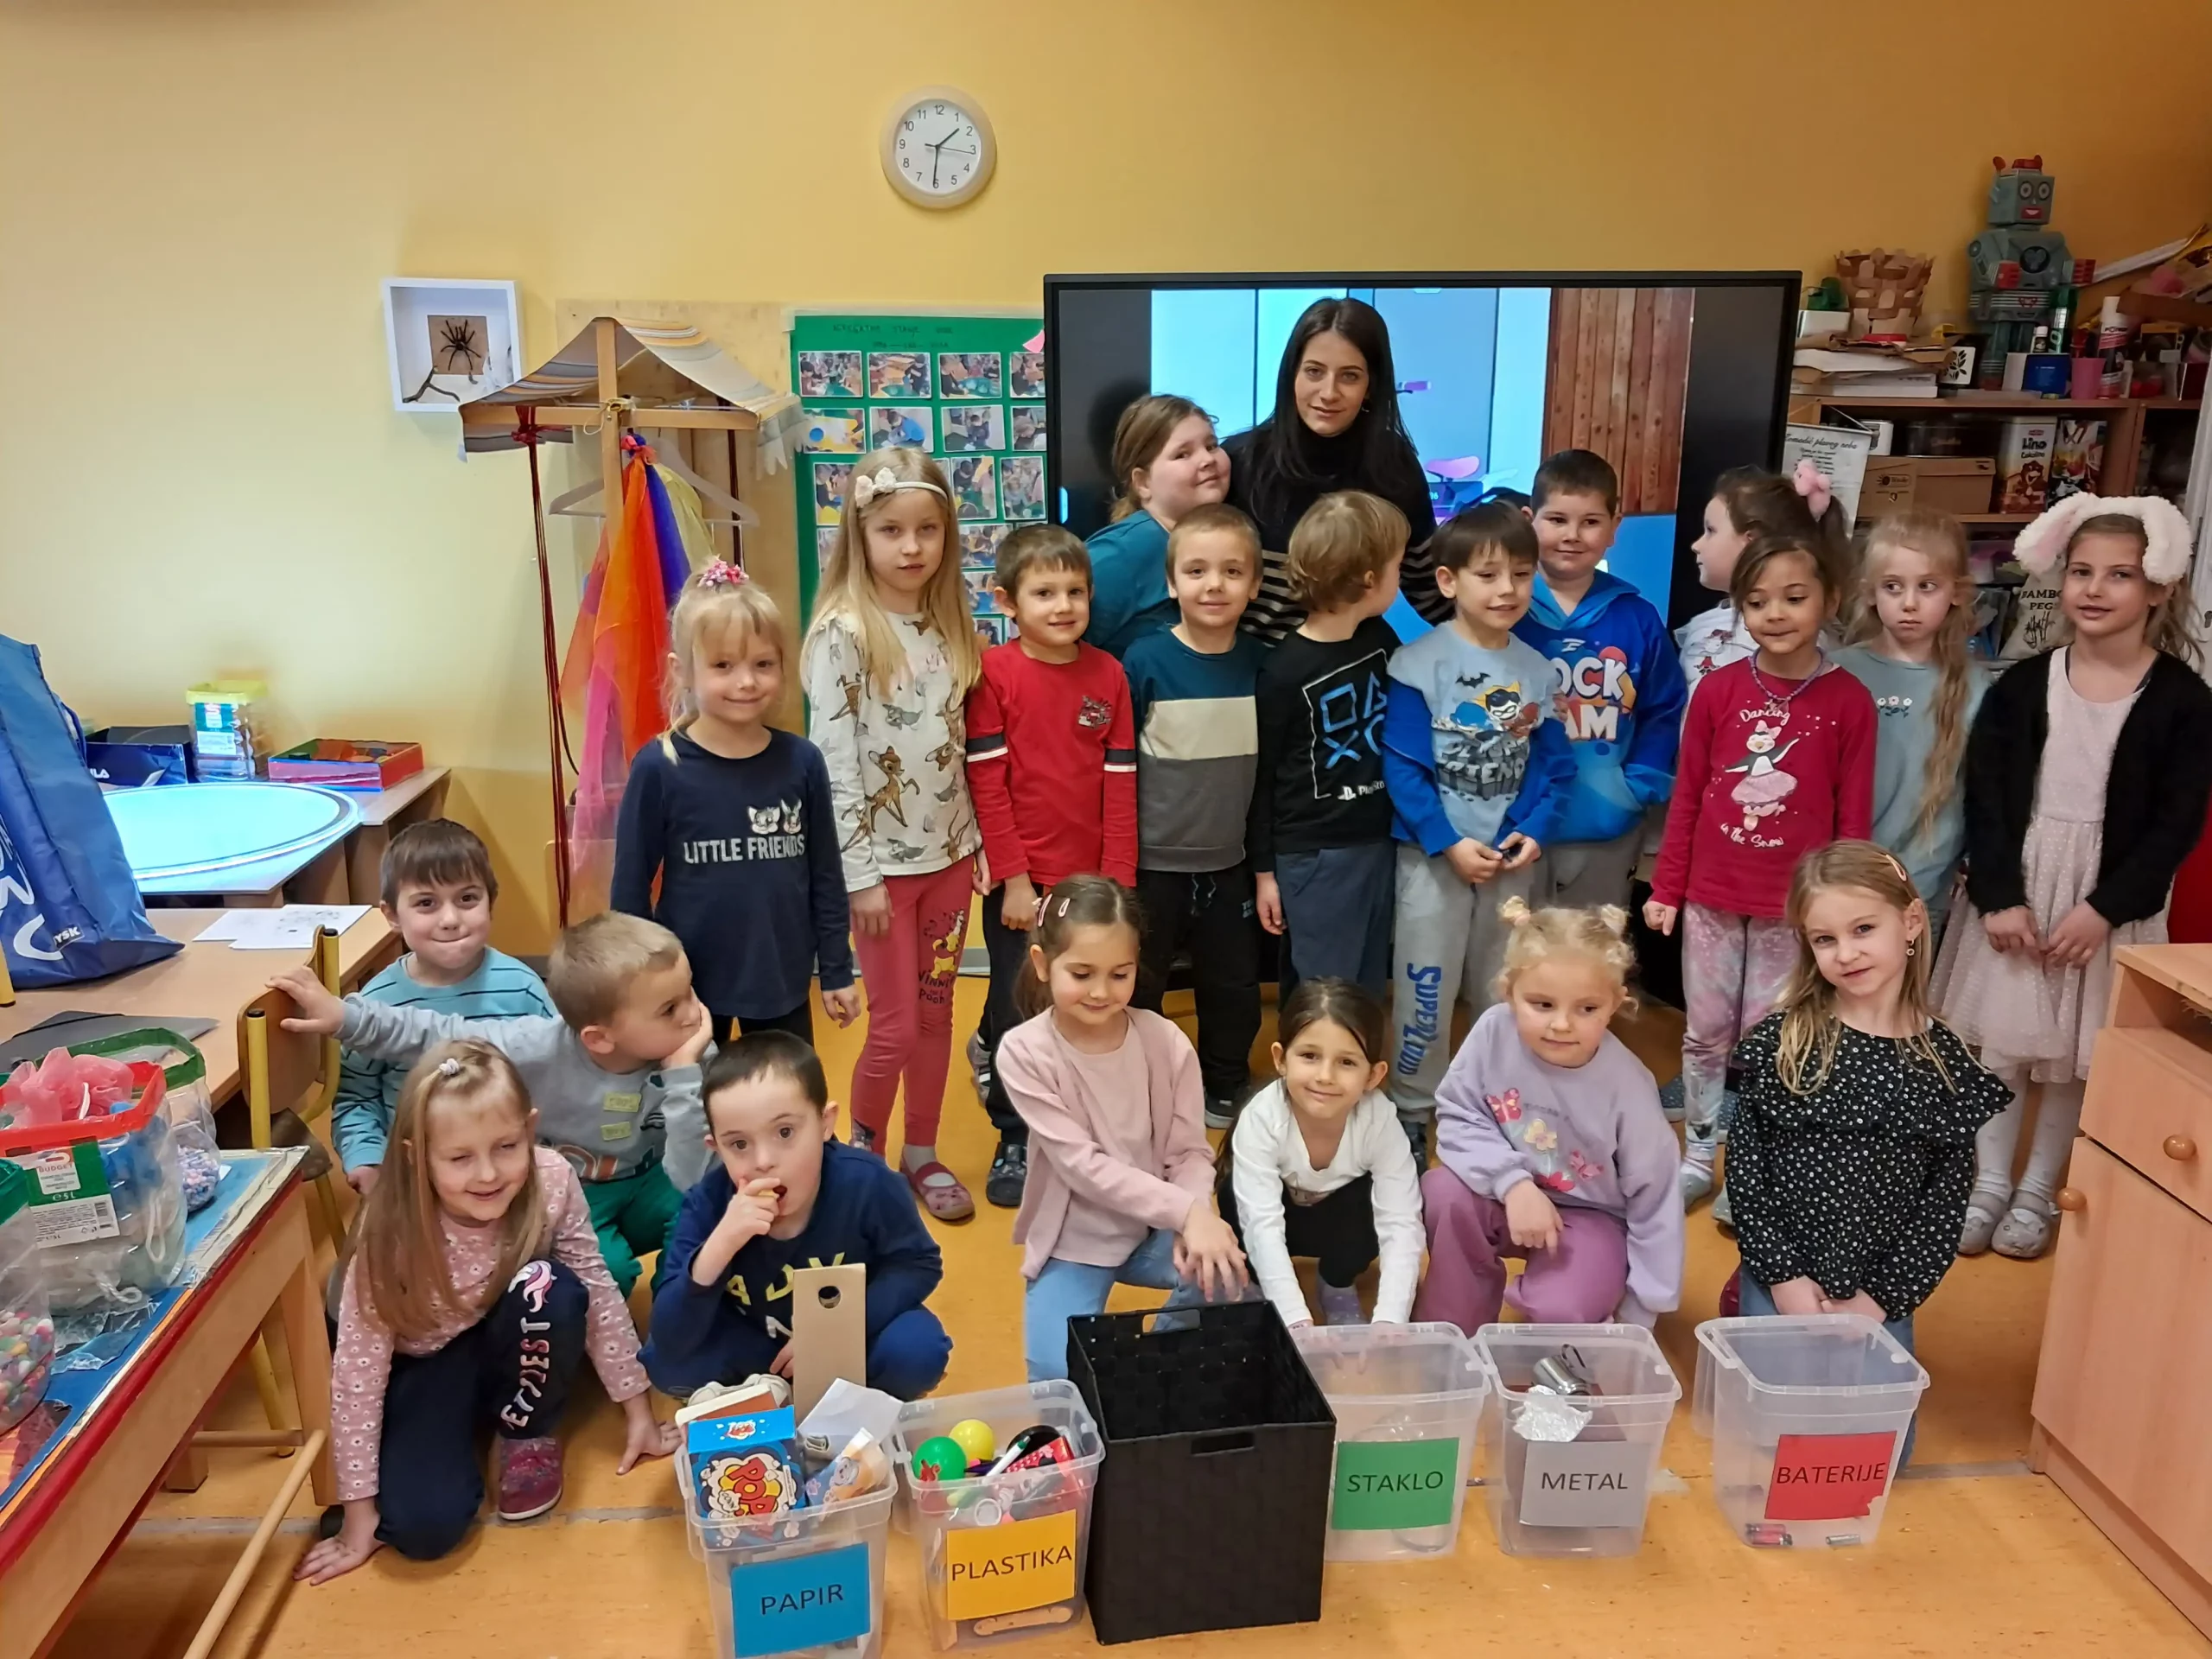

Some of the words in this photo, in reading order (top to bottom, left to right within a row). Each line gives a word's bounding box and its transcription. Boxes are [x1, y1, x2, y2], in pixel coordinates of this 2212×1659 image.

[918, 110, 926, 119] 11
[934, 105, 944, 115] 12
[904, 121, 914, 131] 10
[966, 126, 973, 136] 2
[899, 139, 906, 149] 9
[970, 145, 976, 154] 3
[903, 158, 910, 168] 8
[963, 163, 969, 173] 4
[916, 172, 923, 181] 7
[951, 175, 957, 185] 5
[933, 179, 938, 188] 6
[2022, 437, 2047, 450] Lino
[1739, 709, 1790, 726] Dancing
[90, 768, 110, 779] ILA
[683, 837, 743, 864] LITTLE
[747, 834, 805, 861] FRIENDS
[54, 926, 80, 943] YSK
[39, 1164, 73, 1173] BUDGET
[1776, 1462, 1886, 1484] BATERIJE
[1347, 1471, 1444, 1493] STAKLO
[1541, 1471, 1629, 1491] METAL
[951, 1545, 1072, 1581] PLASTIKA
[760, 1584, 844, 1616] PAPIR
